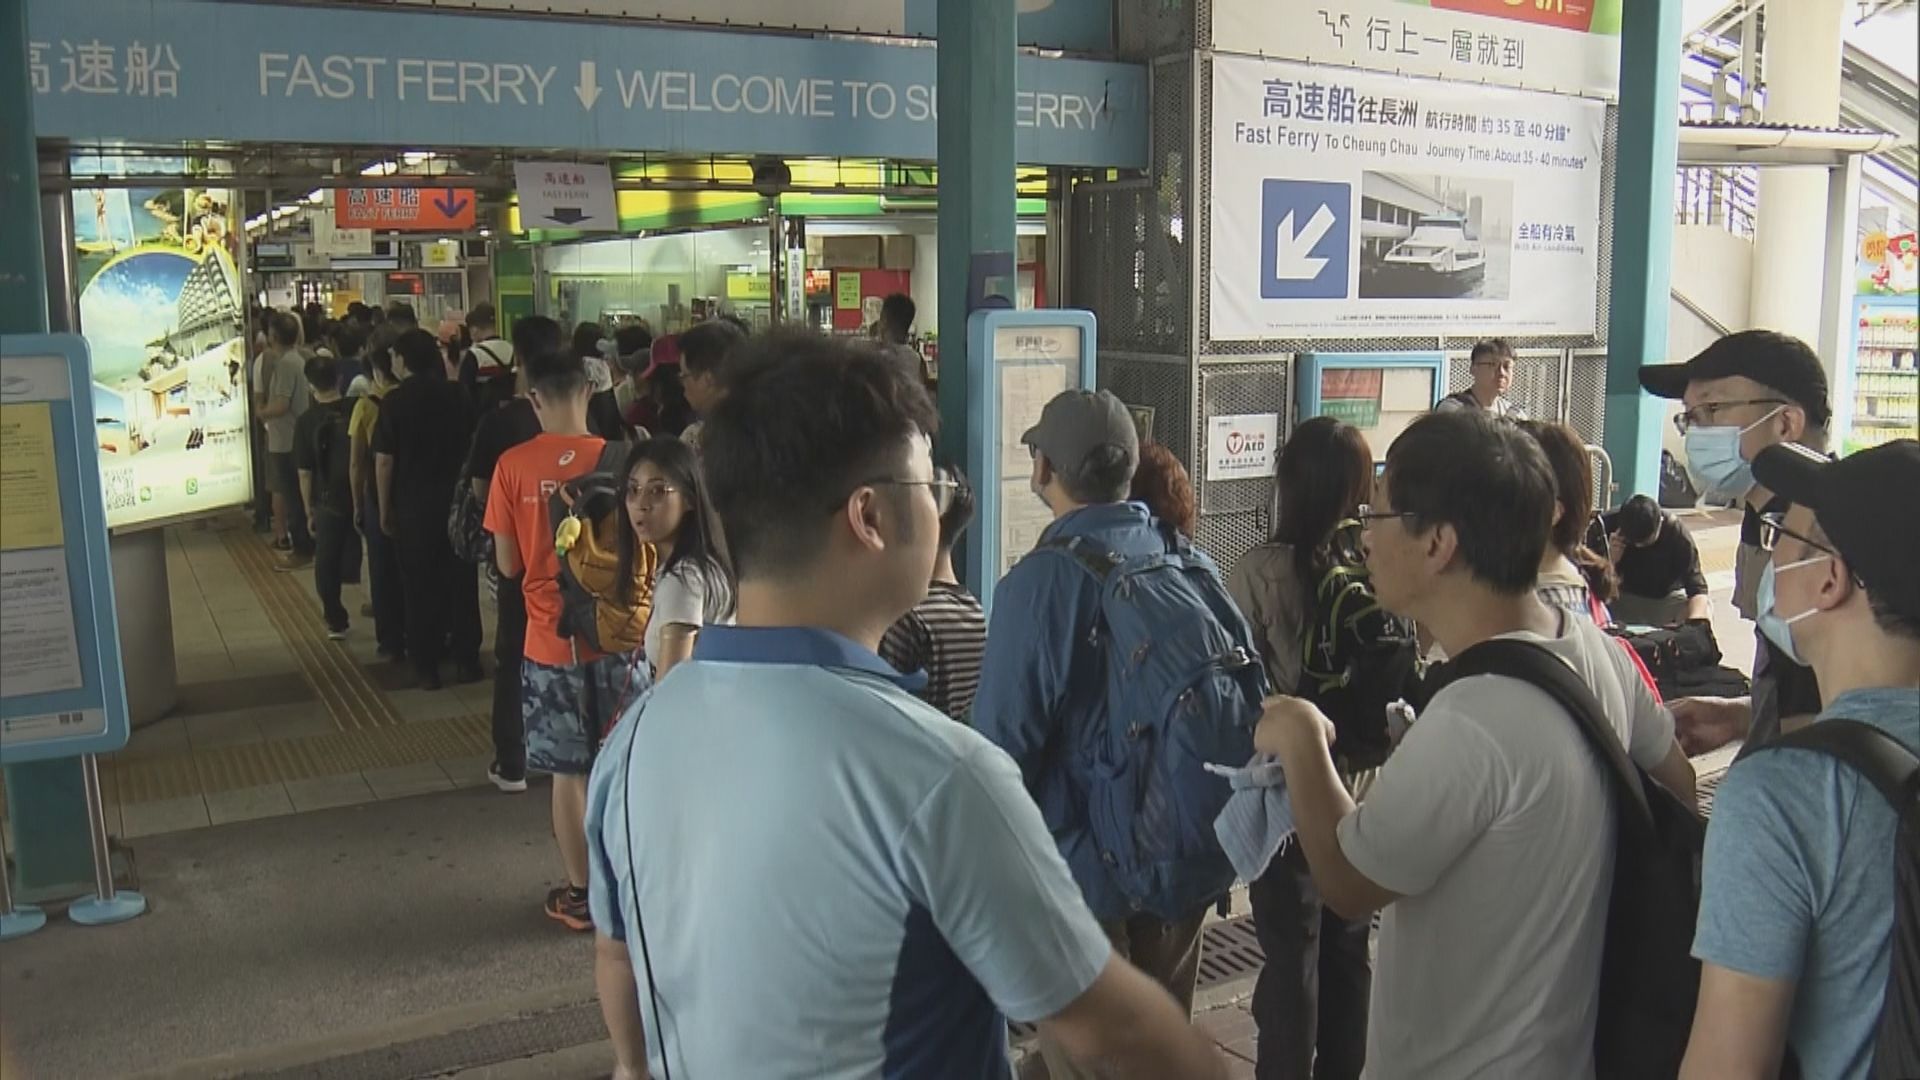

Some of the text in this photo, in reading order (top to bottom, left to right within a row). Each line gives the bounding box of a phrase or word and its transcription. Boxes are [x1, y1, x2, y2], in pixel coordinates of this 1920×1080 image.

[1366, 16, 1525, 70] 行上一層就到
[259, 52, 557, 105] FAST FERRY
[615, 68, 835, 117] WELCOME
[842, 81, 897, 120] TO
[1016, 91, 1106, 131] ERRY
[1262, 78, 1418, 129] 高速船往長洲
[1235, 122, 1418, 157] Fast Ferry To Cheung Chau
[1497, 118, 1511, 134] 35
[1514, 119, 1526, 138] 至
[1528, 123, 1543, 138] 40
[1426, 142, 1466, 163] Journey
[1523, 150, 1534, 165] 35
[1540, 151, 1551, 167] 40
[544, 171, 585, 186] 高速船
[543, 190, 561, 200] FAST
[348, 206, 420, 221] FAST FERRY
[1518, 221, 1576, 242] 全船有冷氣
[1244, 442, 1265, 452] AED
